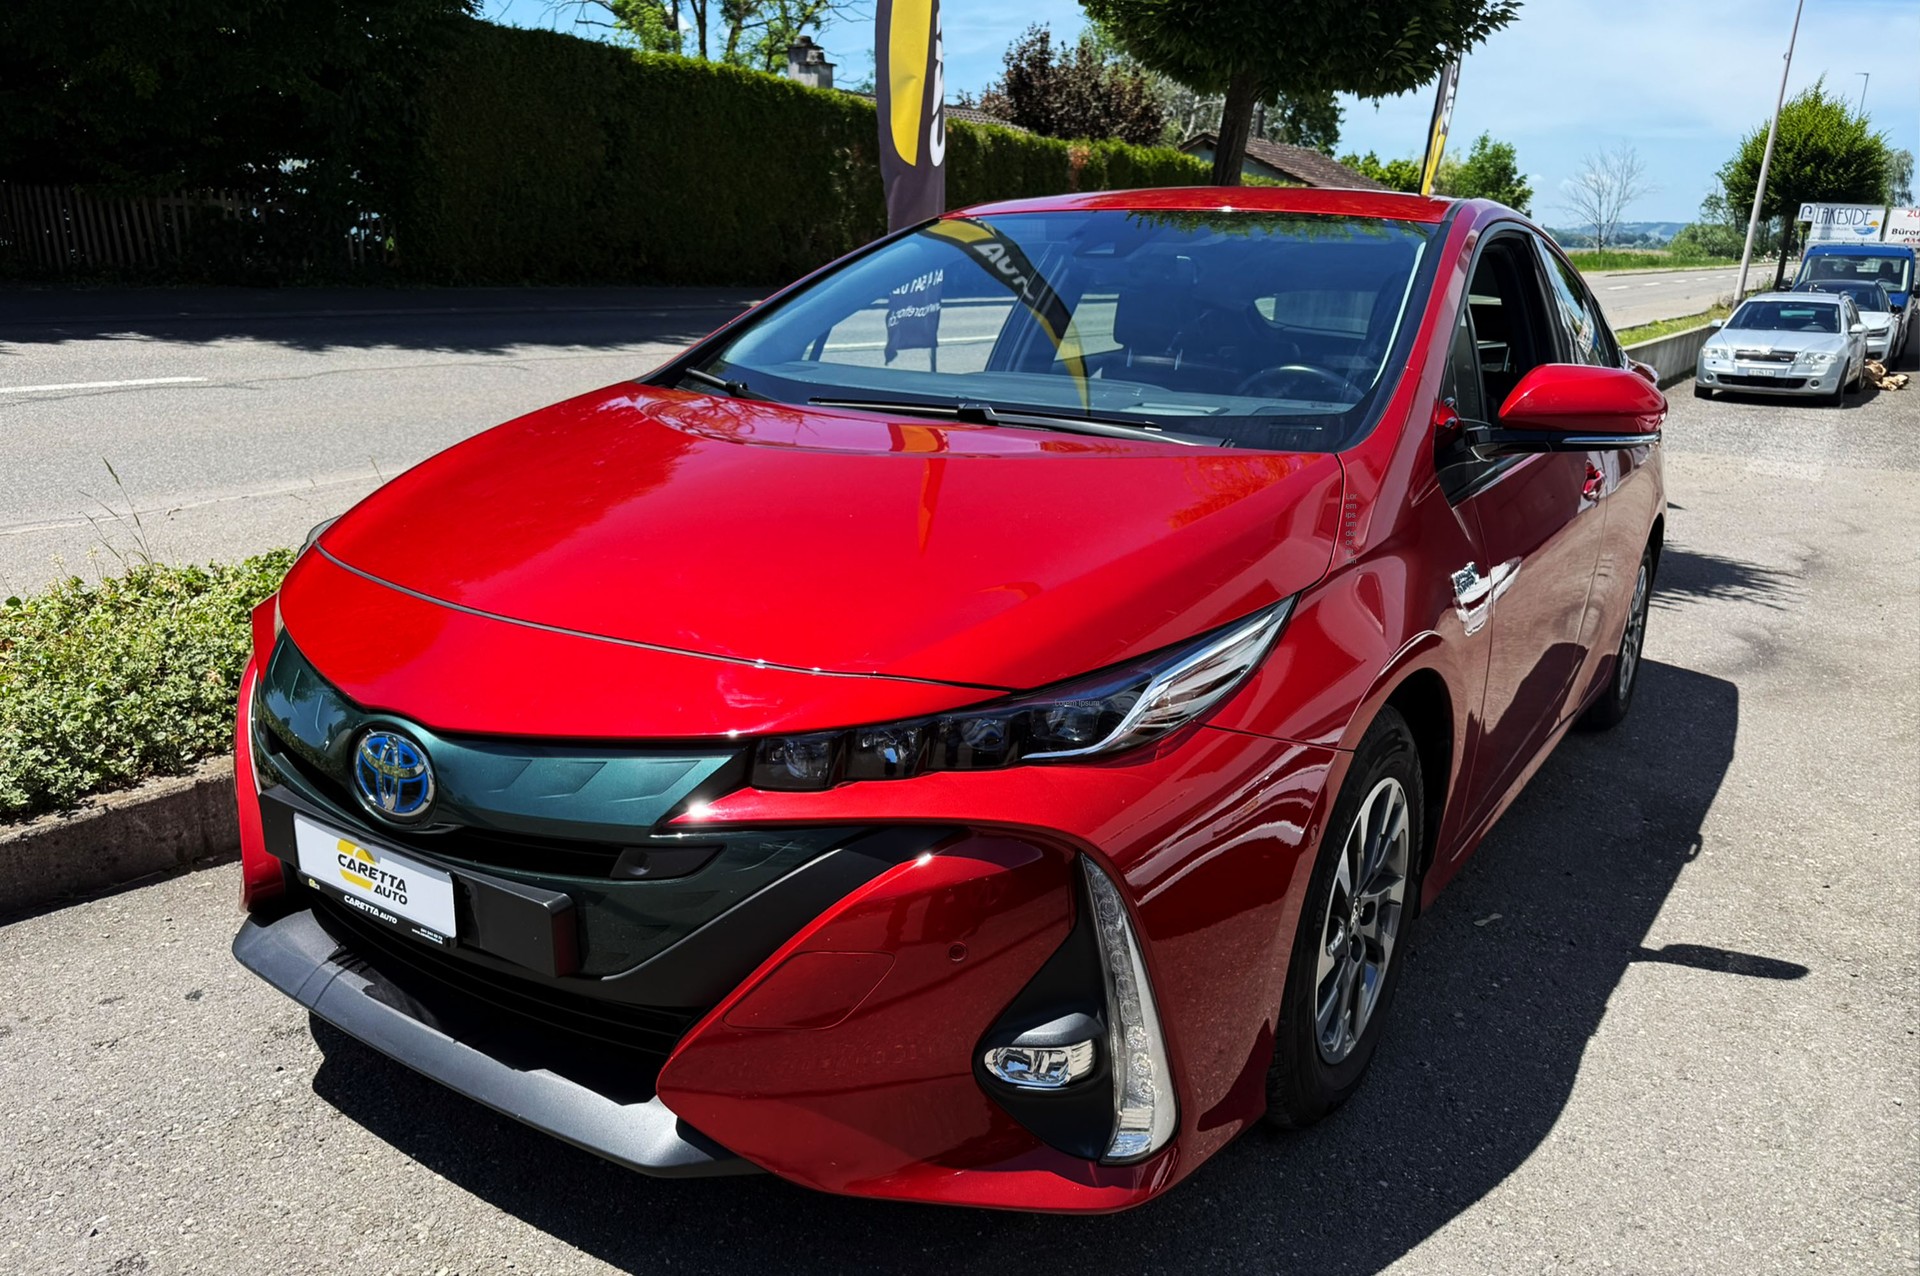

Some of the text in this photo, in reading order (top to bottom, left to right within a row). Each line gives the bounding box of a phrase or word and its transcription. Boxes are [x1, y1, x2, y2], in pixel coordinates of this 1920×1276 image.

[1815, 206, 1872, 226] LAKESIDE
[337, 853, 407, 893] CARETTA
[373, 885, 408, 906] AUTO
[343, 894, 398, 924] CARETTA AUTO
